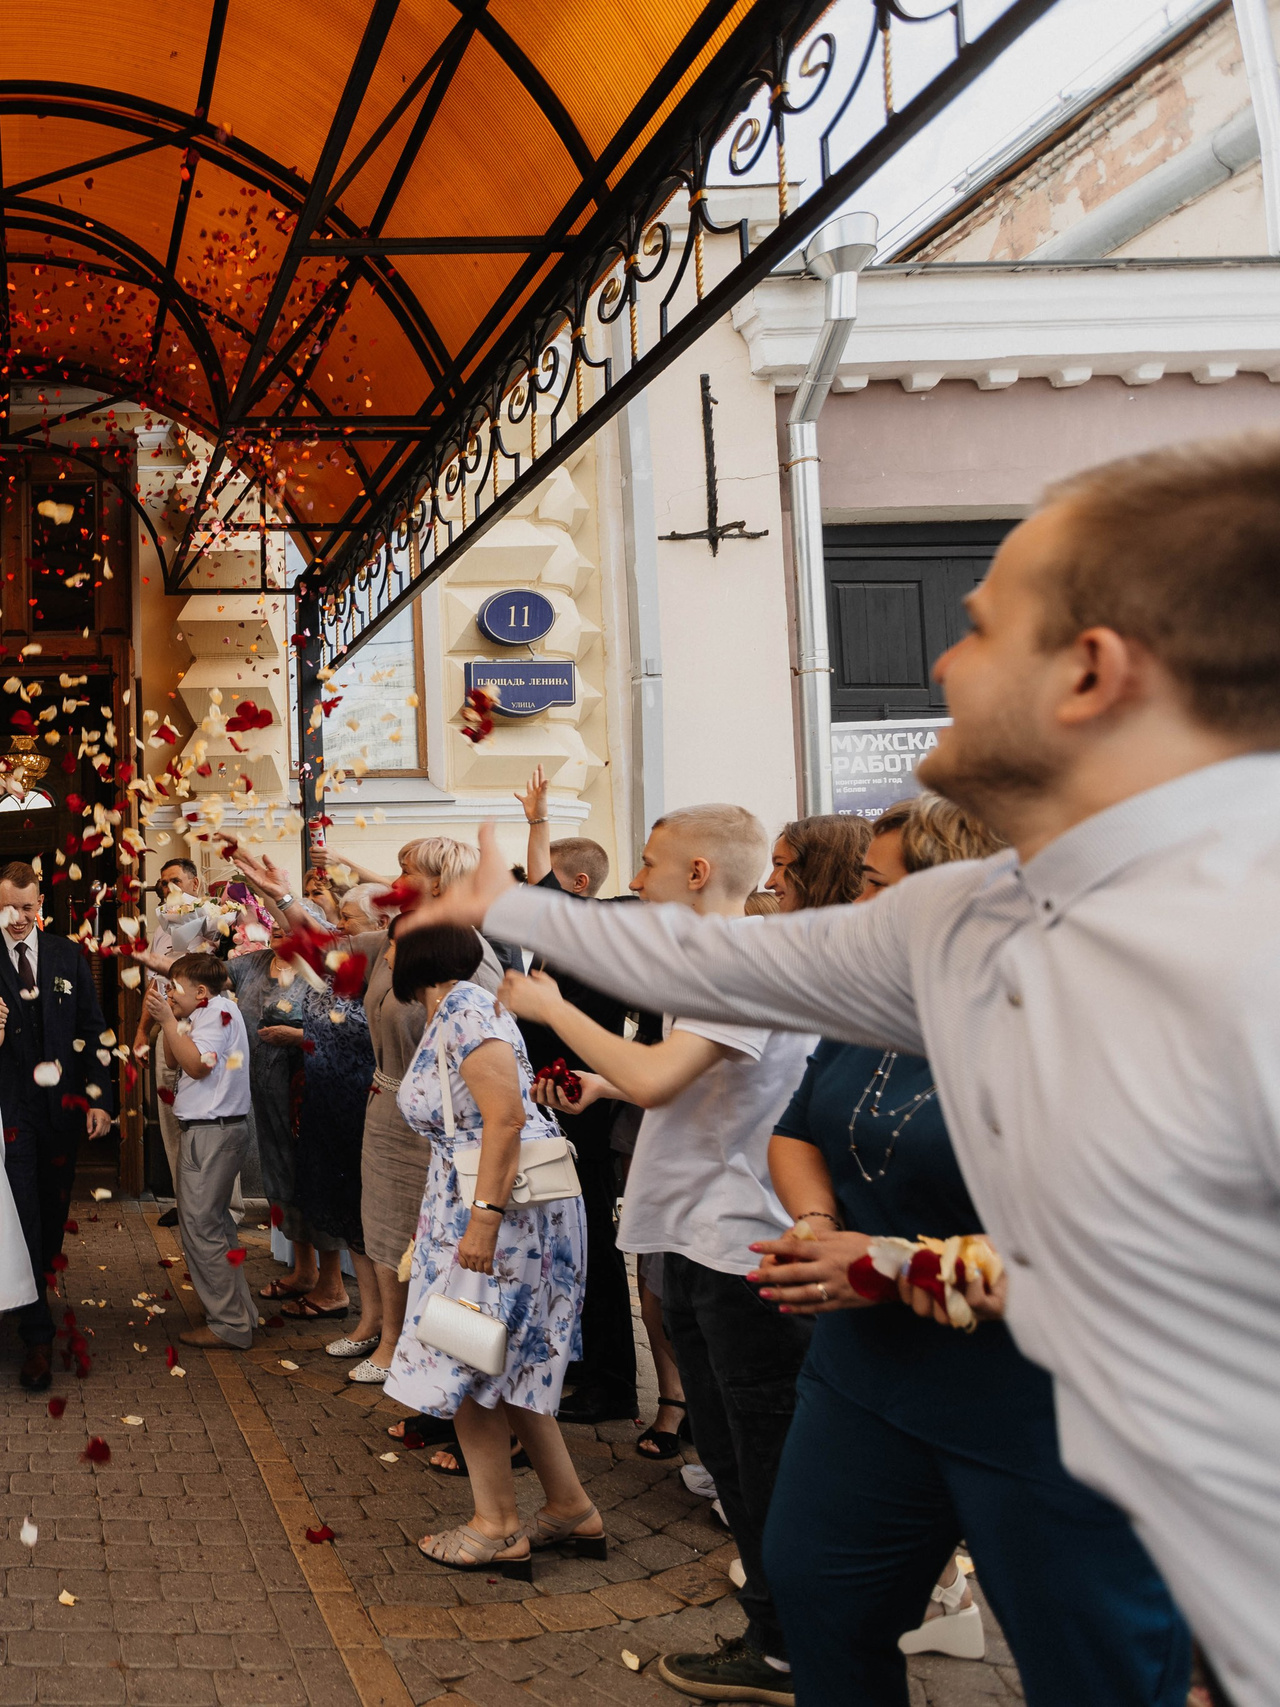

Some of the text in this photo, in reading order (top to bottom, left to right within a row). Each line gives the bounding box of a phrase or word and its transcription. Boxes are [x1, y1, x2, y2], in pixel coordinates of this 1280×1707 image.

[508, 605, 530, 627] 11
[477, 678, 568, 686] ПЛОЩАДЬ ЛЕНИНА
[511, 701, 536, 709] УЛИЦА
[833, 753, 927, 774] РАБОТ
